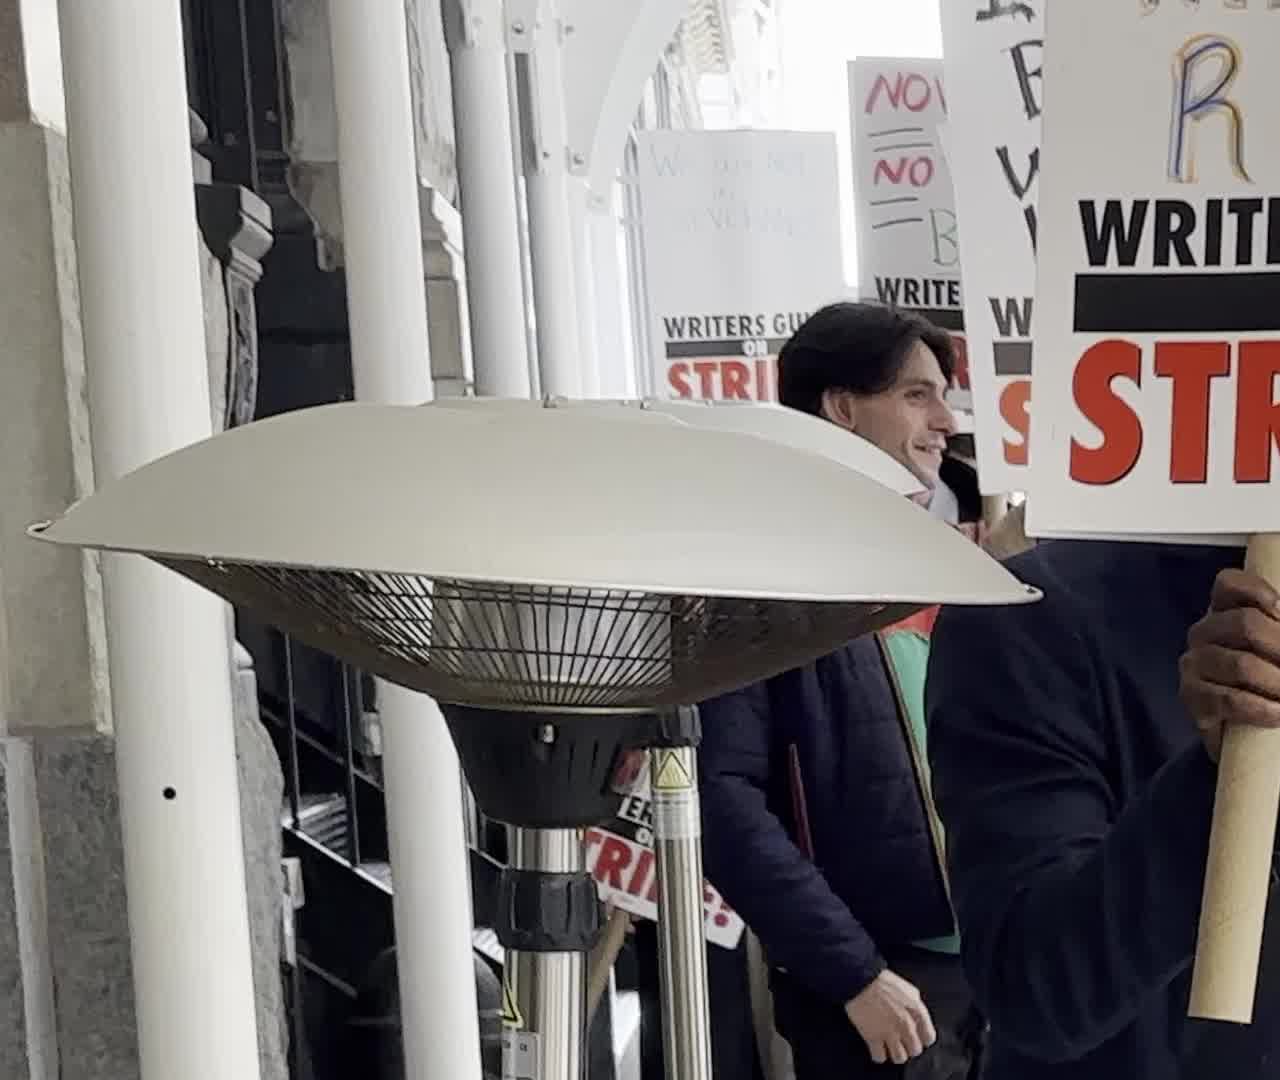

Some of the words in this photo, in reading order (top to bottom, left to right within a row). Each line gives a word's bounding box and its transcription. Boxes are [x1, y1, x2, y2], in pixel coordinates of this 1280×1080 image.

[865, 72, 947, 114] NO
[874, 157, 934, 188] NO
[875, 275, 961, 307] WRITE
[664, 315, 766, 338] WRITERS
[742, 340, 768, 357] ON
[668, 360, 779, 401] STRI
[636, 827, 654, 846] O
